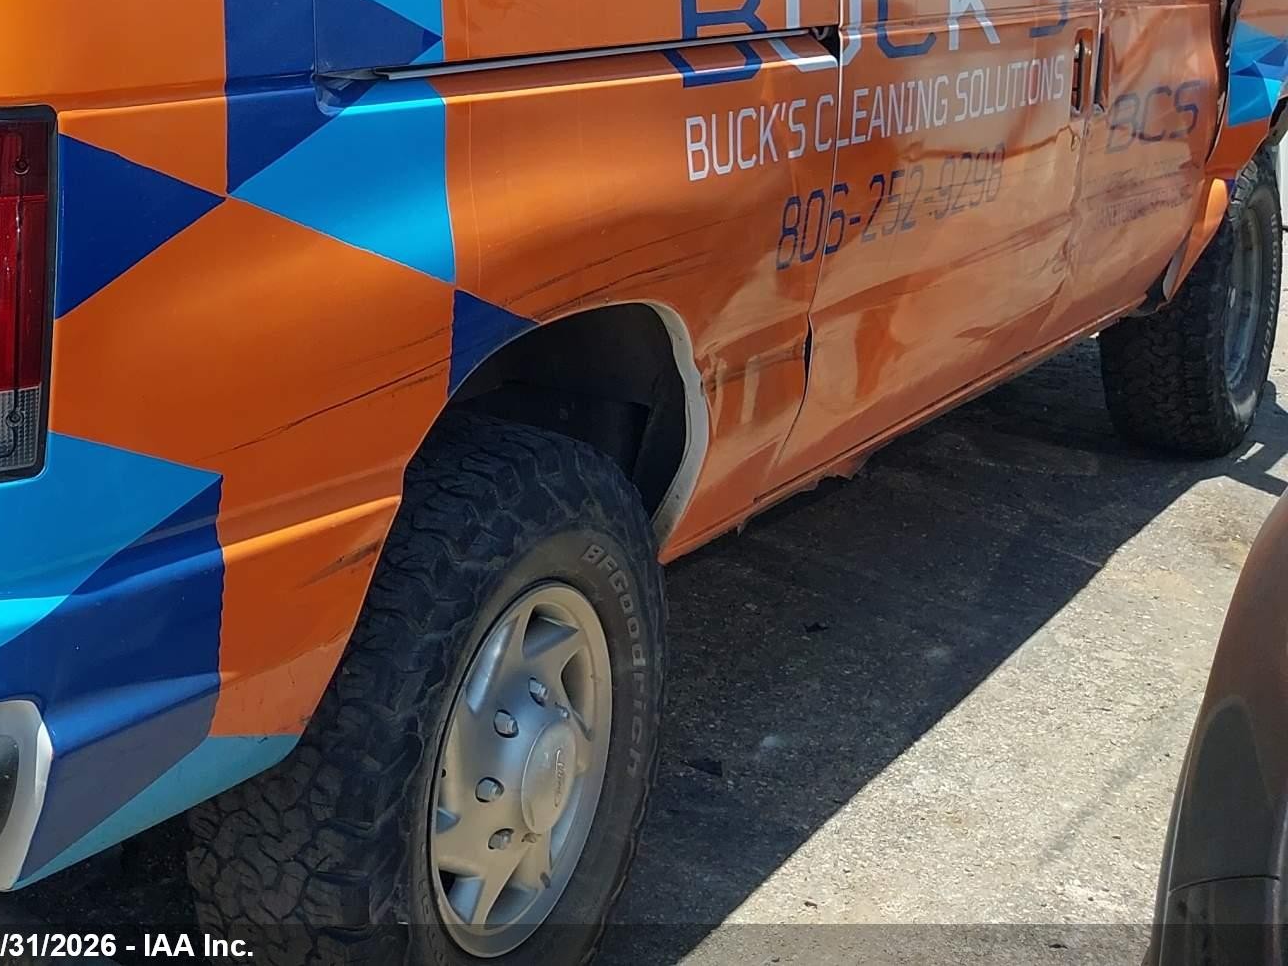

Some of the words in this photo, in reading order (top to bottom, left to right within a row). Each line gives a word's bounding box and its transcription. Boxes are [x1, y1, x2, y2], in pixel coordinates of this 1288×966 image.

[685, 94, 807, 182] BUCK'S
[814, 70, 949, 153] CLEANING
[954, 54, 1066, 123] SOLUTIONS
[1104, 78, 1202, 155] BCS
